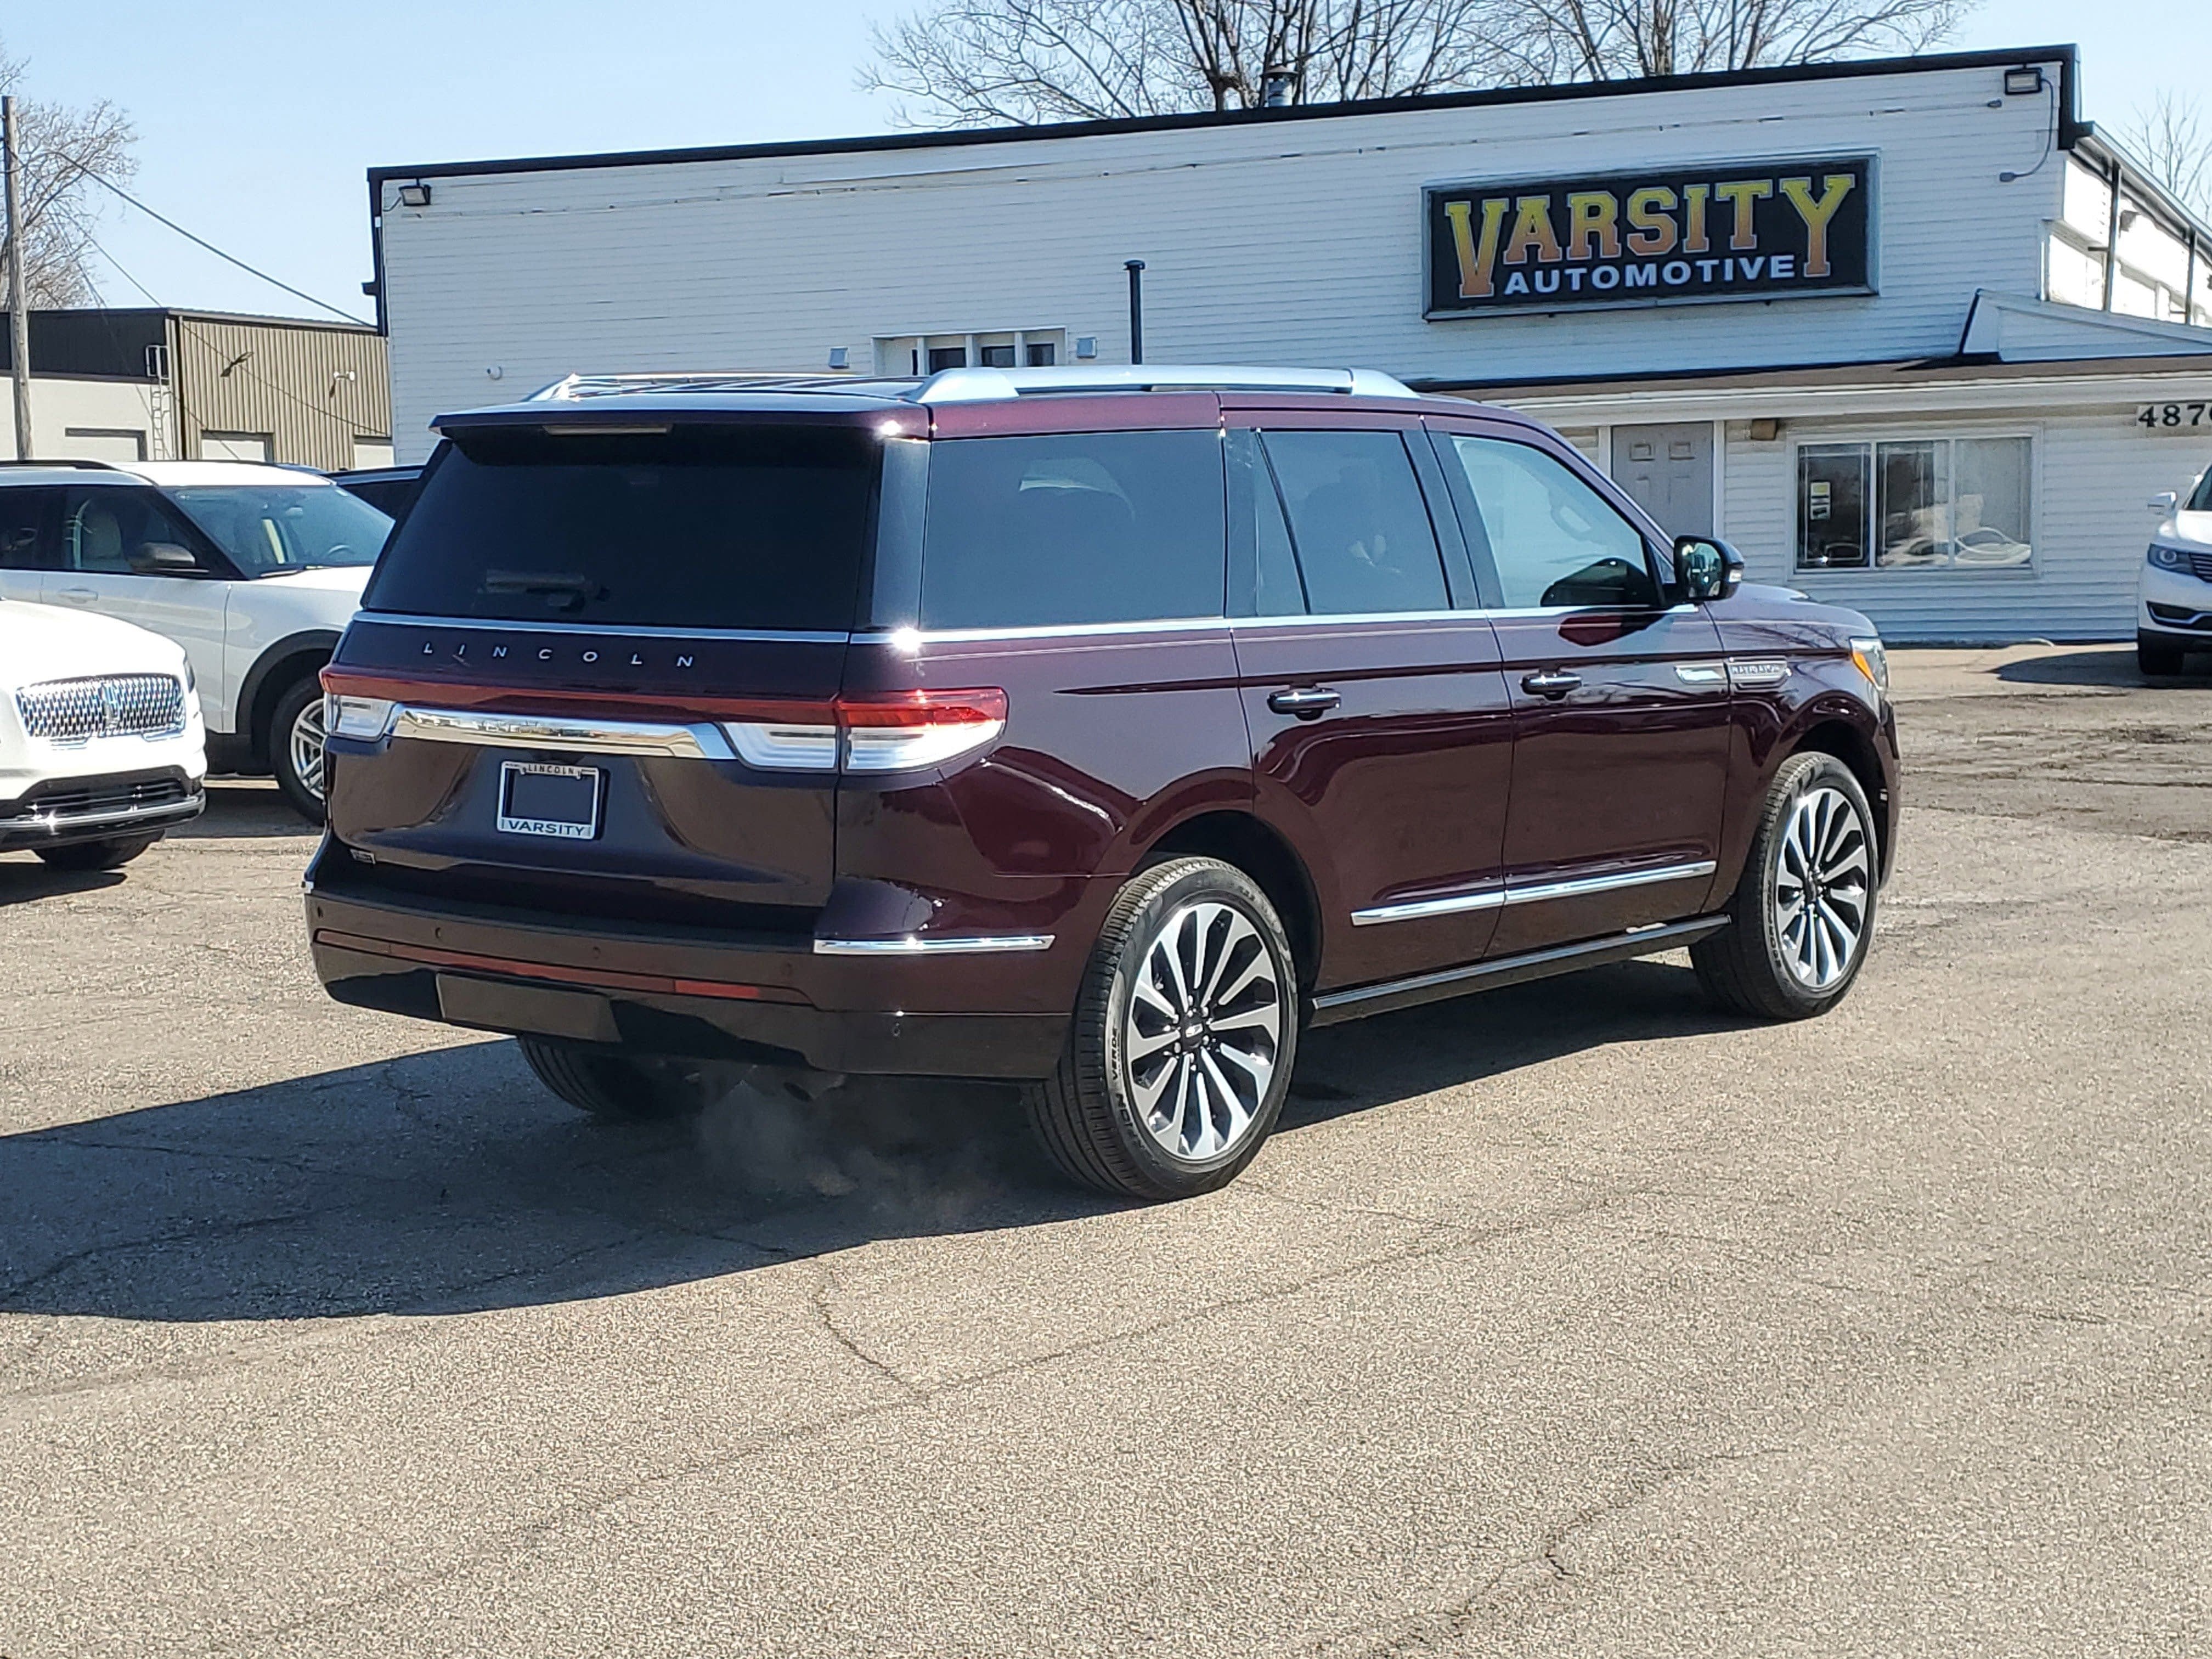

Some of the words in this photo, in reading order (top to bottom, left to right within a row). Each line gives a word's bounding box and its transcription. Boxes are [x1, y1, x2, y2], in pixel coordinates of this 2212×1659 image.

[1444, 174, 1856, 298] VARSITY
[1504, 255, 1795, 295] AUTOMOTIVE
[423, 642, 693, 667] LINCOLN
[528, 764, 574, 775] LINCOLN
[508, 820, 585, 836] VARSITY
